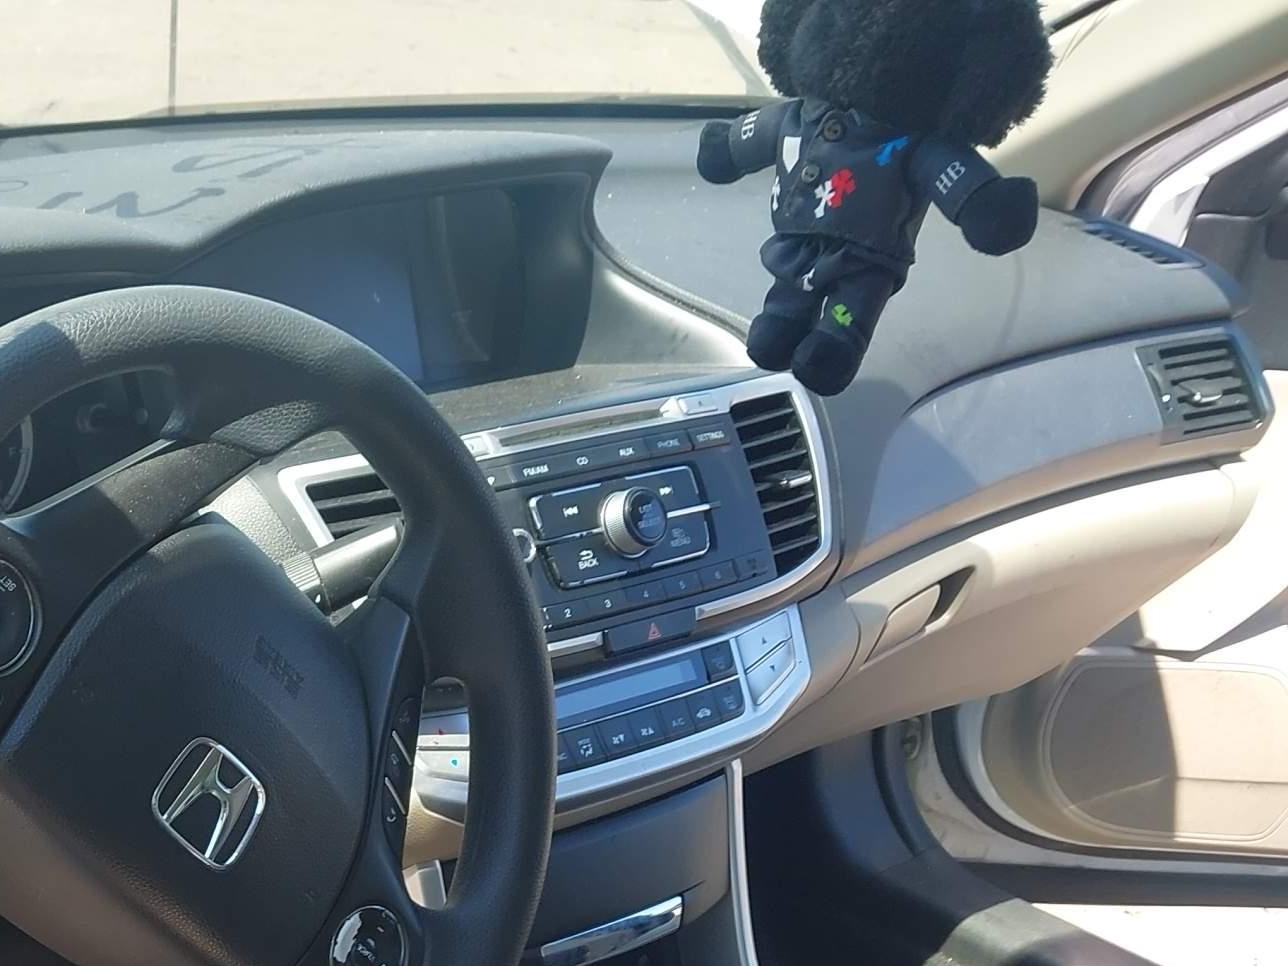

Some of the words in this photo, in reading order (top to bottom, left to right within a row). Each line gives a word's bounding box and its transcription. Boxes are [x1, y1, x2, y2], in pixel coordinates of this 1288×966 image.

[740, 110, 762, 140] HB
[935, 161, 967, 195] HB
[695, 430, 725, 443] SETTINGS
[619, 447, 635, 457] AUX
[576, 456, 589, 465] CD
[578, 557, 600, 570] BACK
[604, 598, 612, 608] 3
[564, 607, 573, 618] 2
